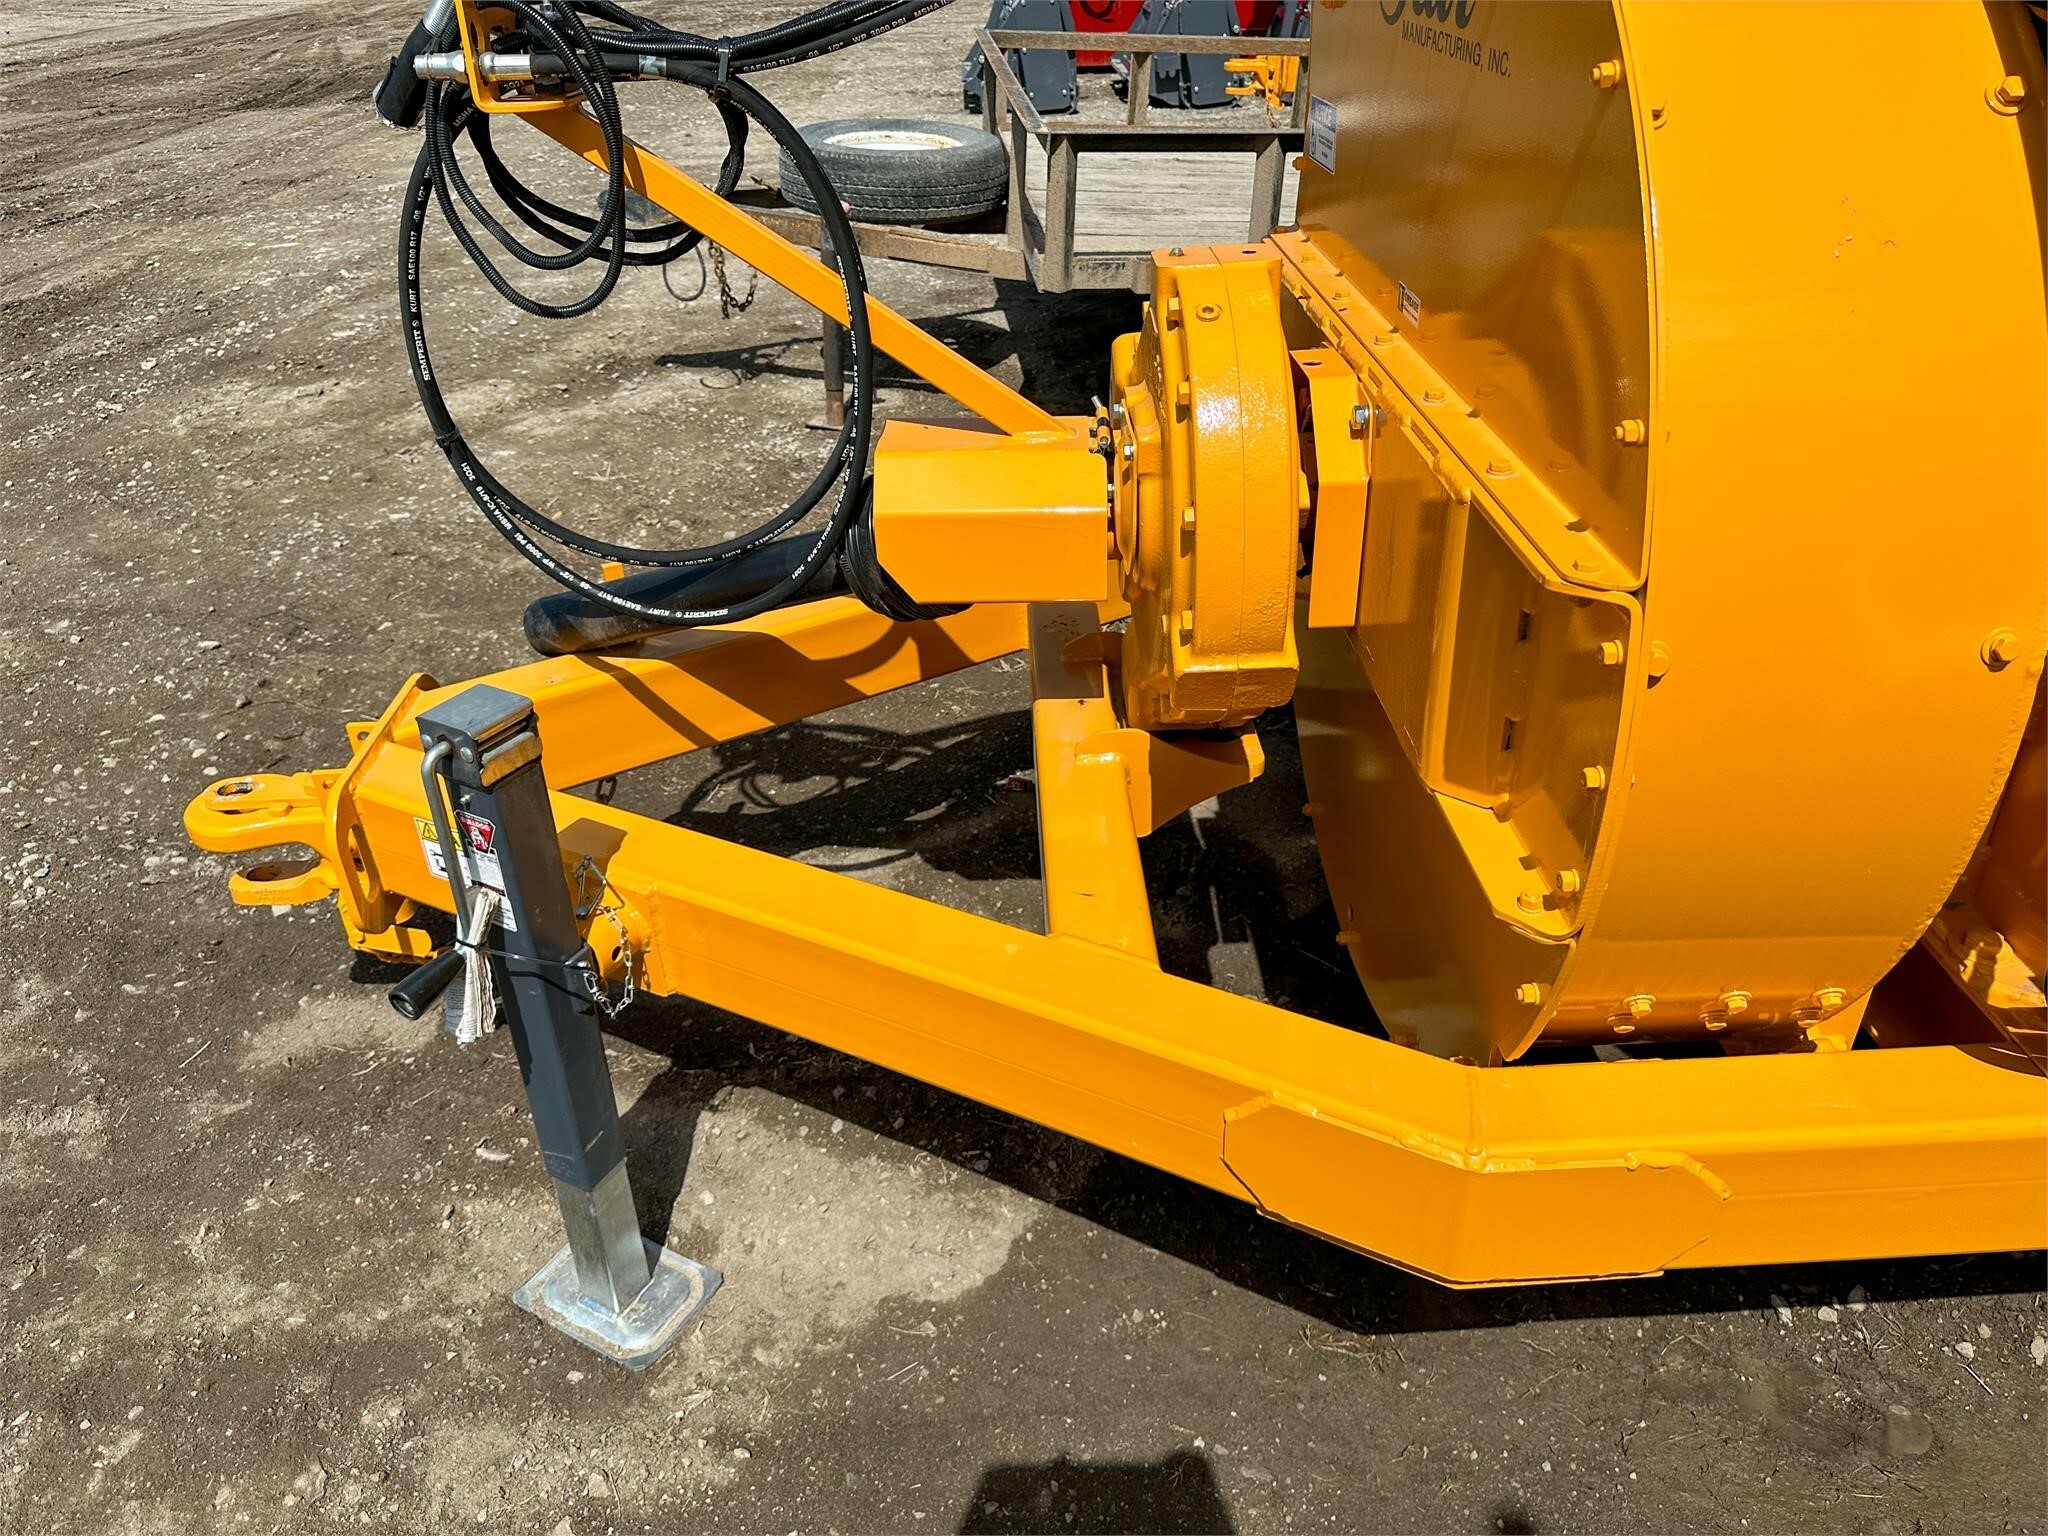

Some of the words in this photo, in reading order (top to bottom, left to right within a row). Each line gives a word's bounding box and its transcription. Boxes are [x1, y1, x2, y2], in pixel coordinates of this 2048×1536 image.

[852, 33, 867, 44] WP
[870, 24, 891, 37] 3000
[891, 17, 907, 29] PSI
[913, 3, 941, 19] MSHA
[1402, 20, 1484, 72] MANUFACTURING,
[1488, 48, 1511, 77] INC.
[453, 107, 474, 127] MSHA
[413, 210, 421, 222] -08
[408, 249, 416, 280] SAE100
[409, 289, 418, 312] KURT
[413, 329, 431, 381] SEMPERIT
[460, 462, 476, 481] 3Q21
[475, 485, 497, 511] IC-8/19
[493, 508, 513, 530] MSHA
[514, 532, 527, 545] PSI
[821, 520, 834, 540] MSHA
[525, 543, 543, 559] 3000
[542, 557, 556, 569] WP
[579, 581, 592, 590] -08
[597, 590, 614, 602] R17
[612, 595, 642, 611] SAE100
[647, 607, 671, 617] KURT
[683, 608, 729, 619] SEMPERIT
